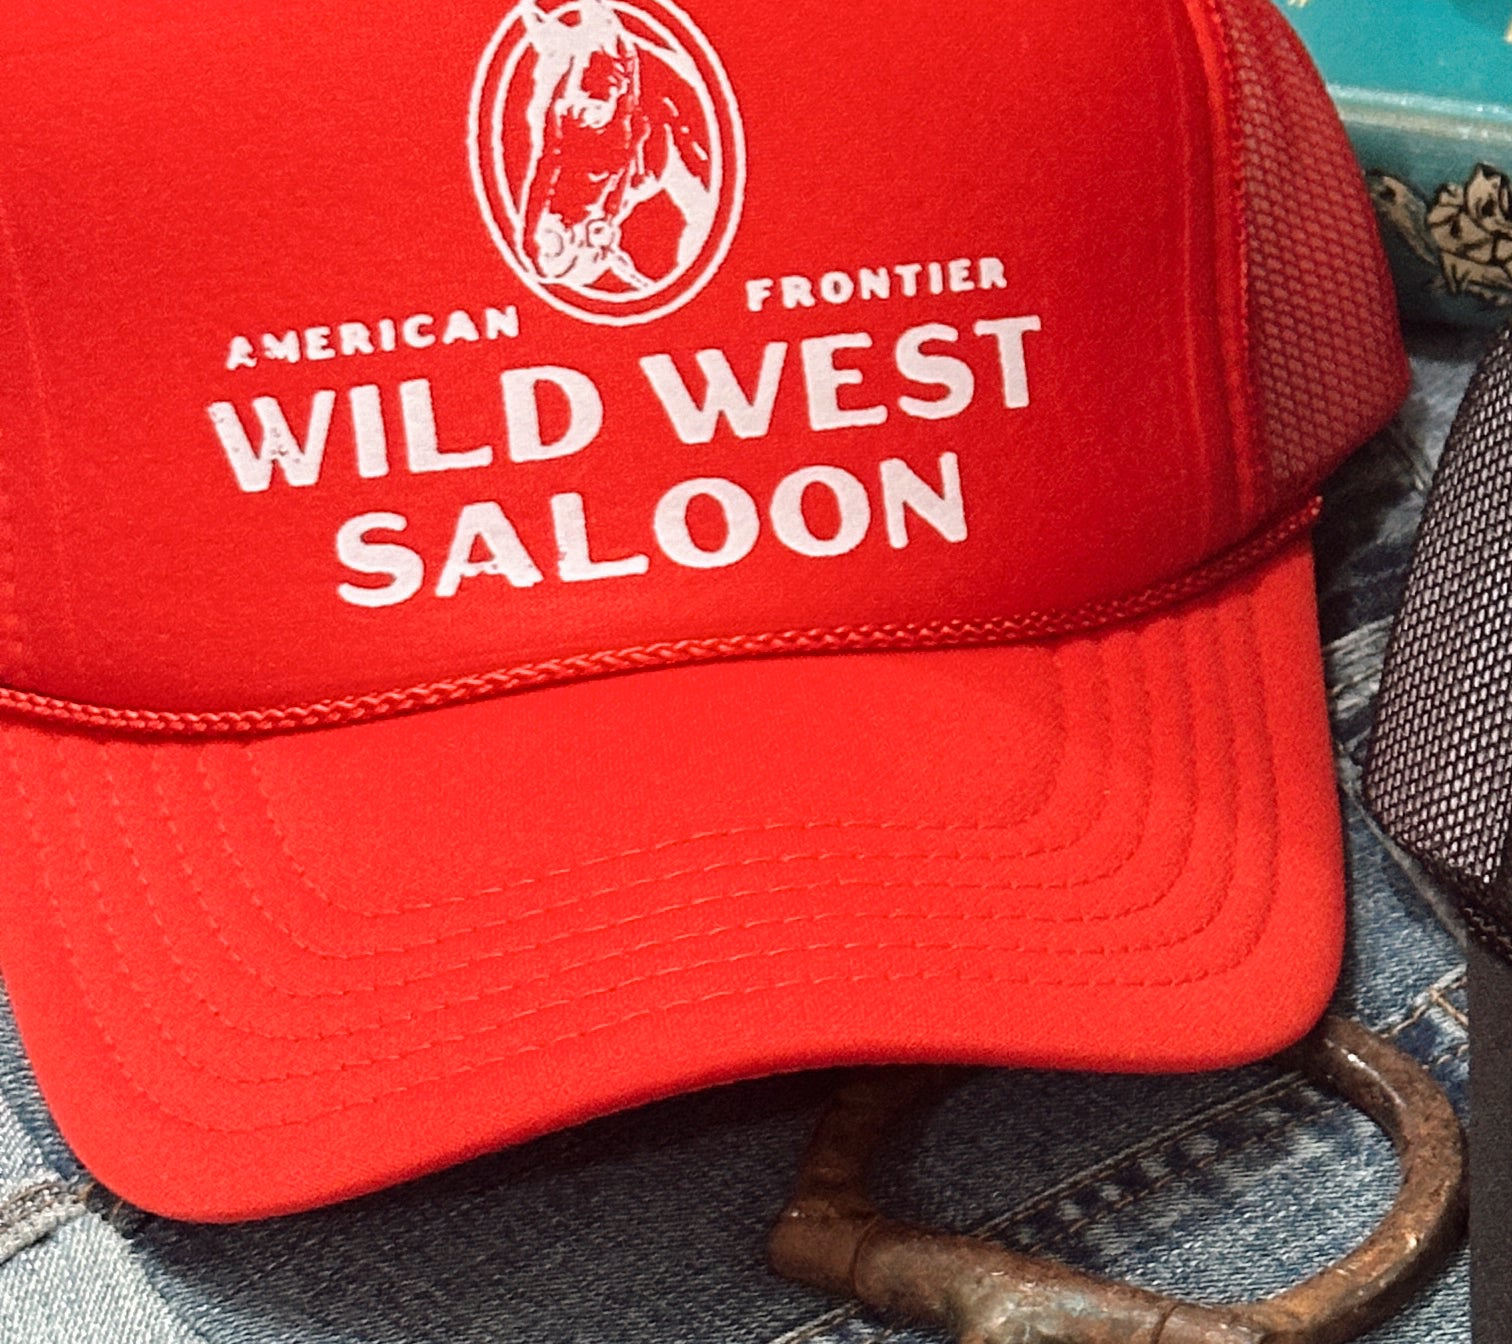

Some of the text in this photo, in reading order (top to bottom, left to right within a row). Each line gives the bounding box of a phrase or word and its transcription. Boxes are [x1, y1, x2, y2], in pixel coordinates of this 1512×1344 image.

[224, 256, 1009, 372] AMERICAN FRONTIER
[205, 314, 1042, 494] WILD WEST
[334, 450, 969, 609] SALOON
